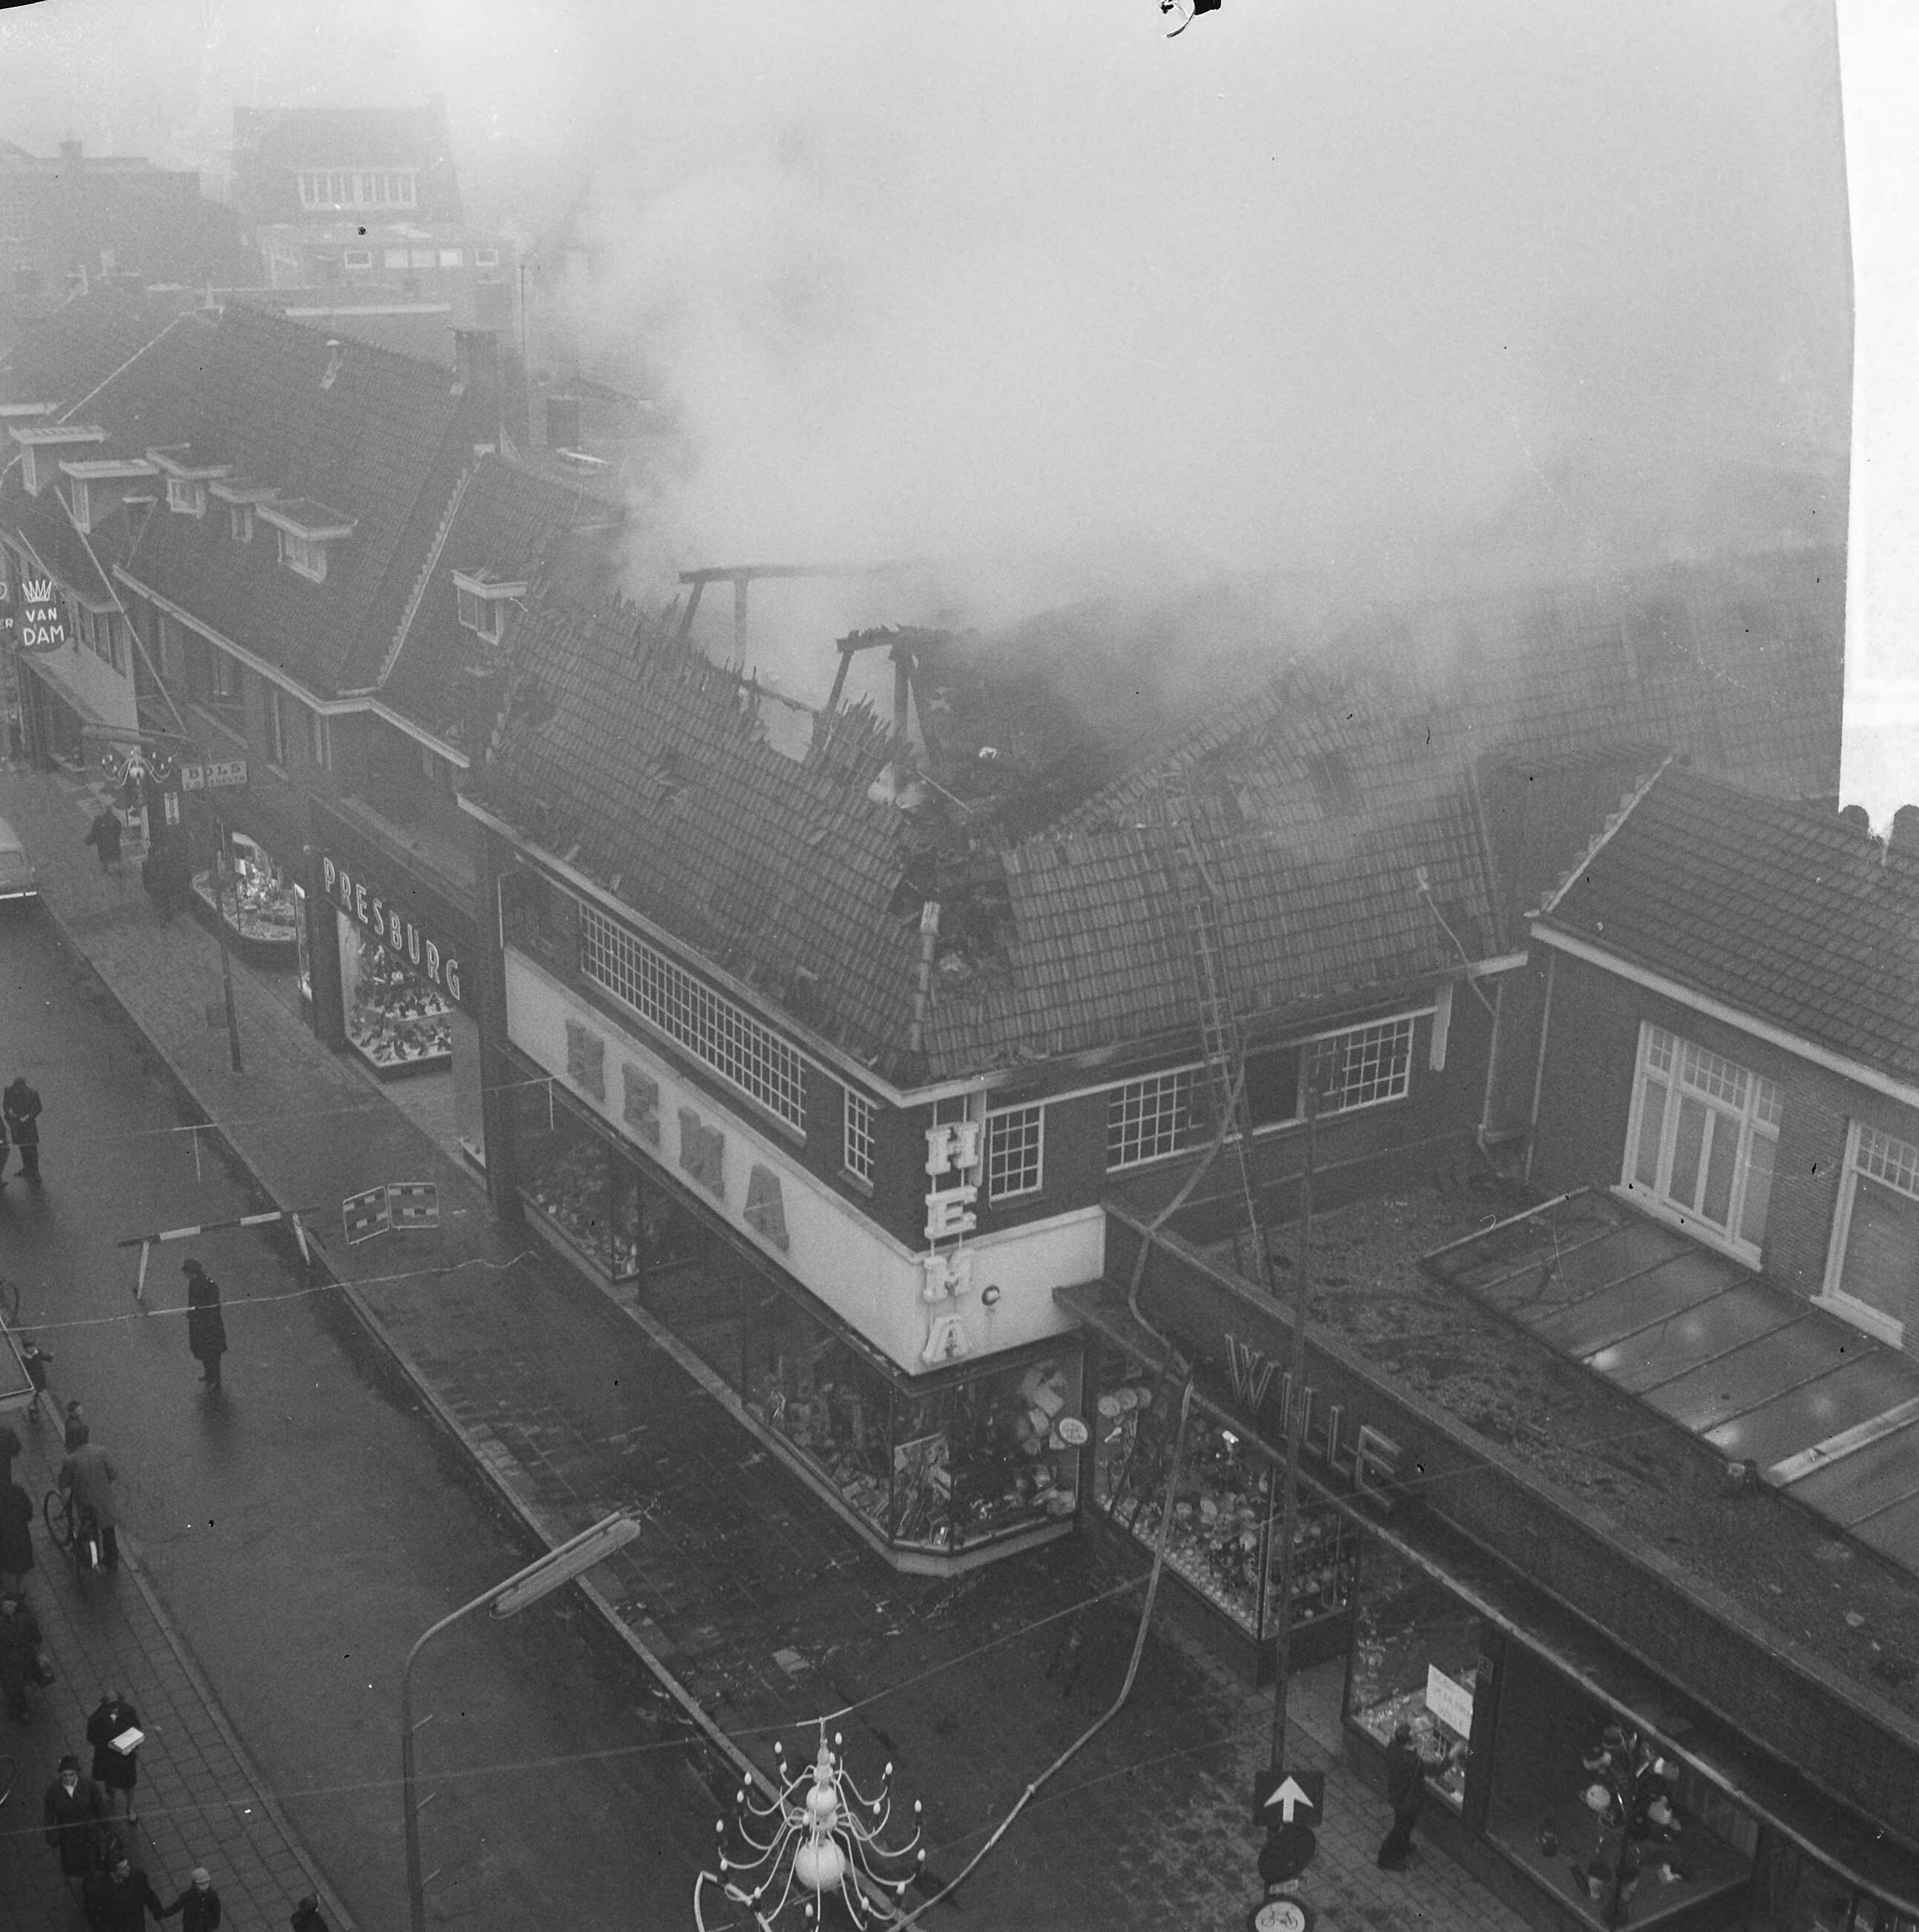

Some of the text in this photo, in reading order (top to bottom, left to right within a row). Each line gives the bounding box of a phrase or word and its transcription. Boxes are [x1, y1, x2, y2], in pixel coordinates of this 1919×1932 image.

[23, 625, 65, 645] DAM
[25, 607, 57, 622] VAN
[323, 857, 461, 1002] PRESBURG
[922, 1121, 980, 1366] HEMA
[1224, 1333, 1404, 1514] WILLE
